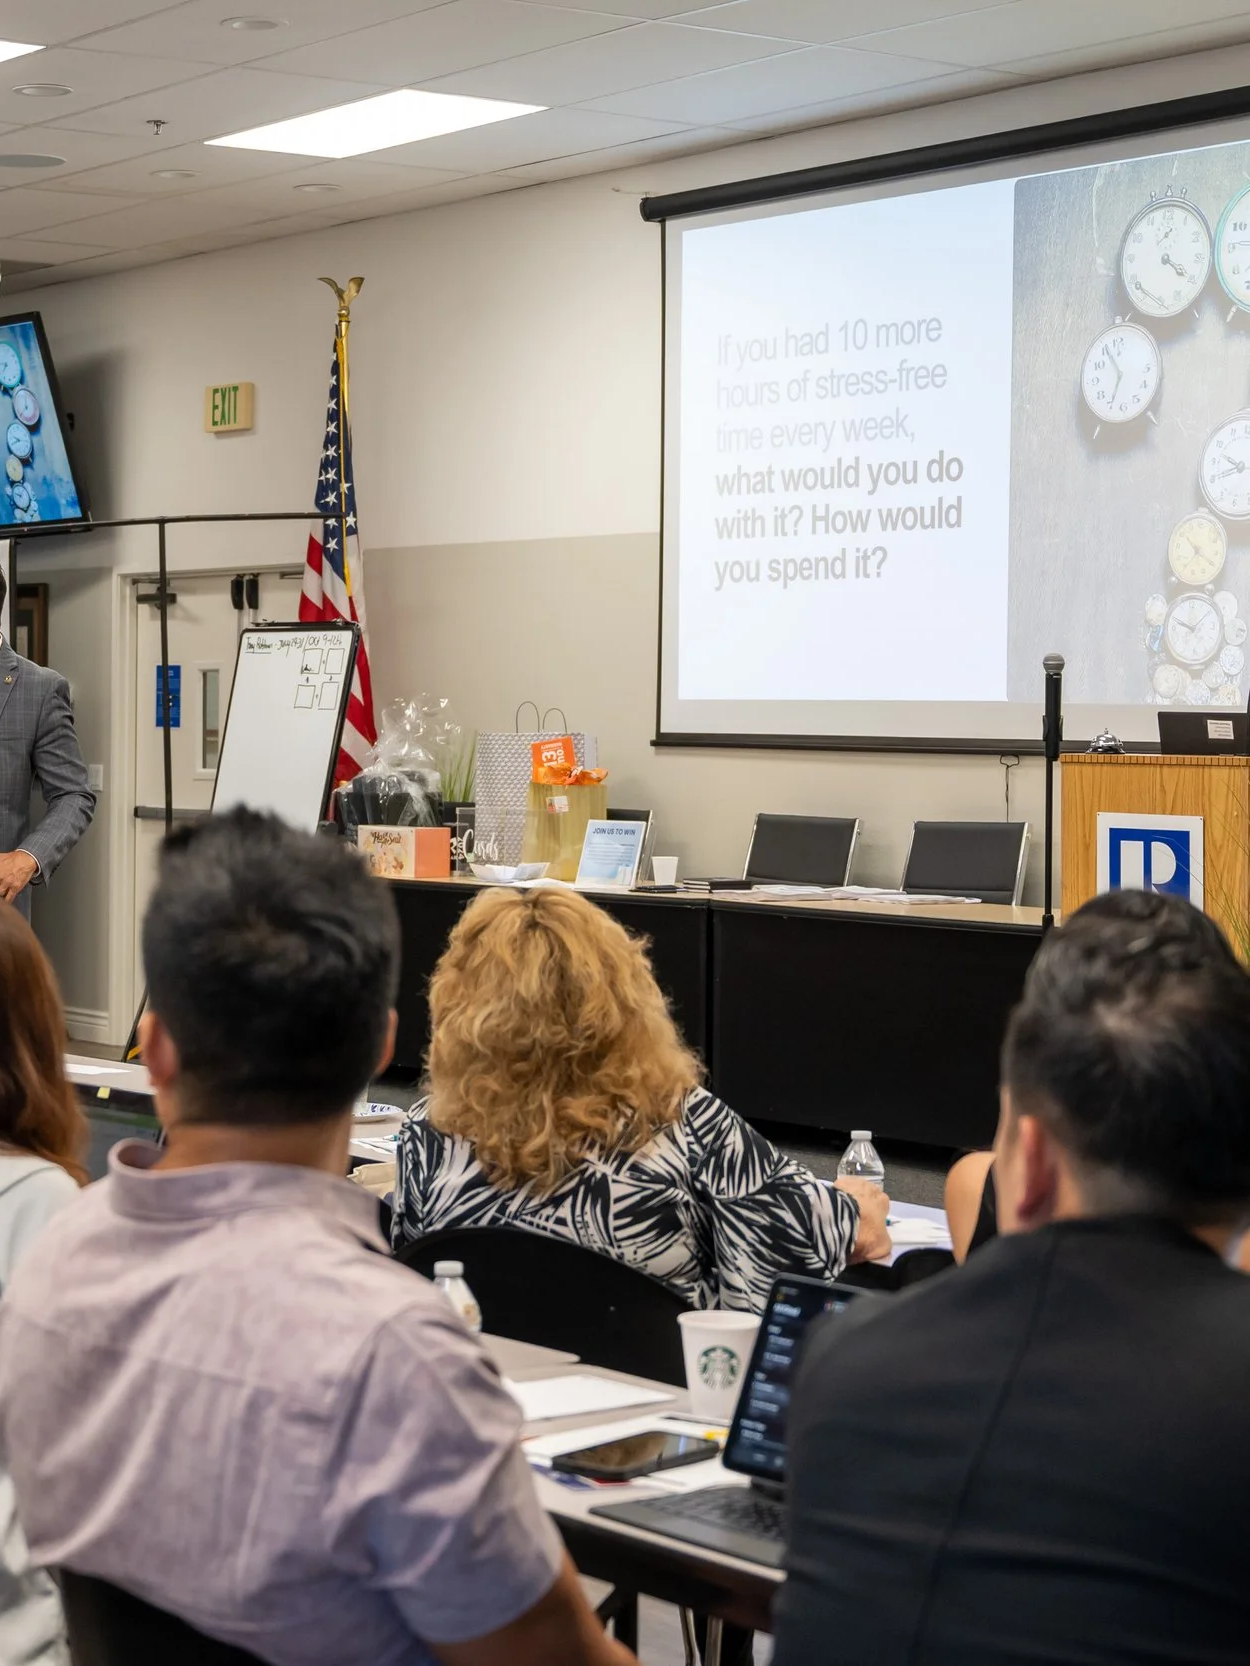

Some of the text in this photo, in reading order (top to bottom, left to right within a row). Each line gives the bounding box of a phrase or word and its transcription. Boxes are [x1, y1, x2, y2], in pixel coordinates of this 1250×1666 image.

[718, 317, 942, 372] If you had 10 more
[212, 386, 239, 426] EXIT
[717, 359, 948, 409] hours of stress-free
[716, 407, 915, 453] time every week,
[715, 450, 964, 497] what would you do
[714, 496, 962, 540] with it? How would
[714, 545, 888, 592] you spend it?
